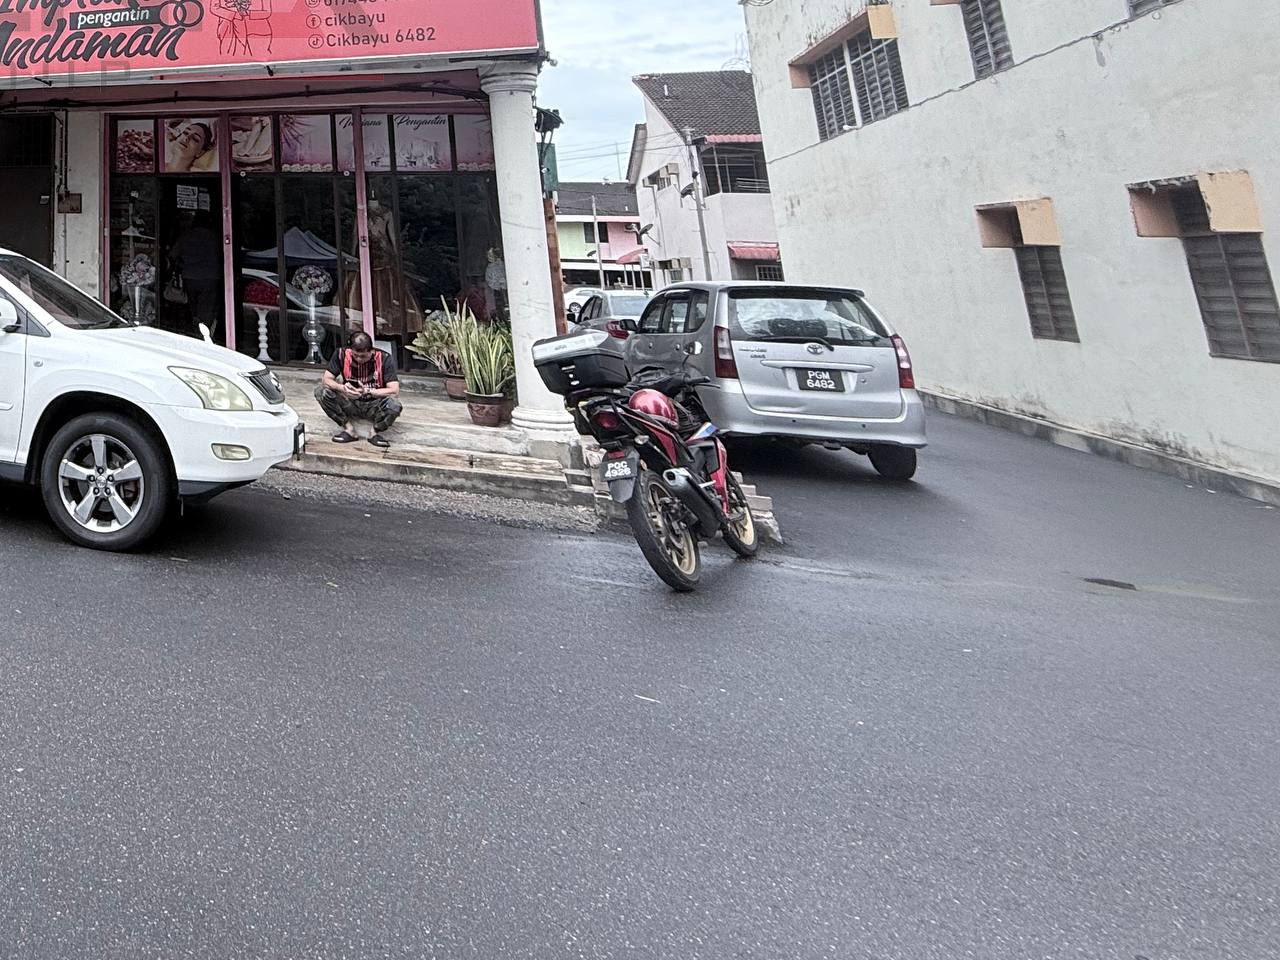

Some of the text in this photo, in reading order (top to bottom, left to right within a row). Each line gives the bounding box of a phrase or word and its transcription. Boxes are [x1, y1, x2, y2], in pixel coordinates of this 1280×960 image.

[77, 6, 150, 29] pengantin
[324, 11, 386, 27] cikbayu
[326, 27, 436, 48] Cikbayu 6482
[394, 115, 446, 130] Pengantin
[807, 370, 831, 380] PGM
[807, 379, 836, 389] 6482
[605, 468, 631, 478] 4926
